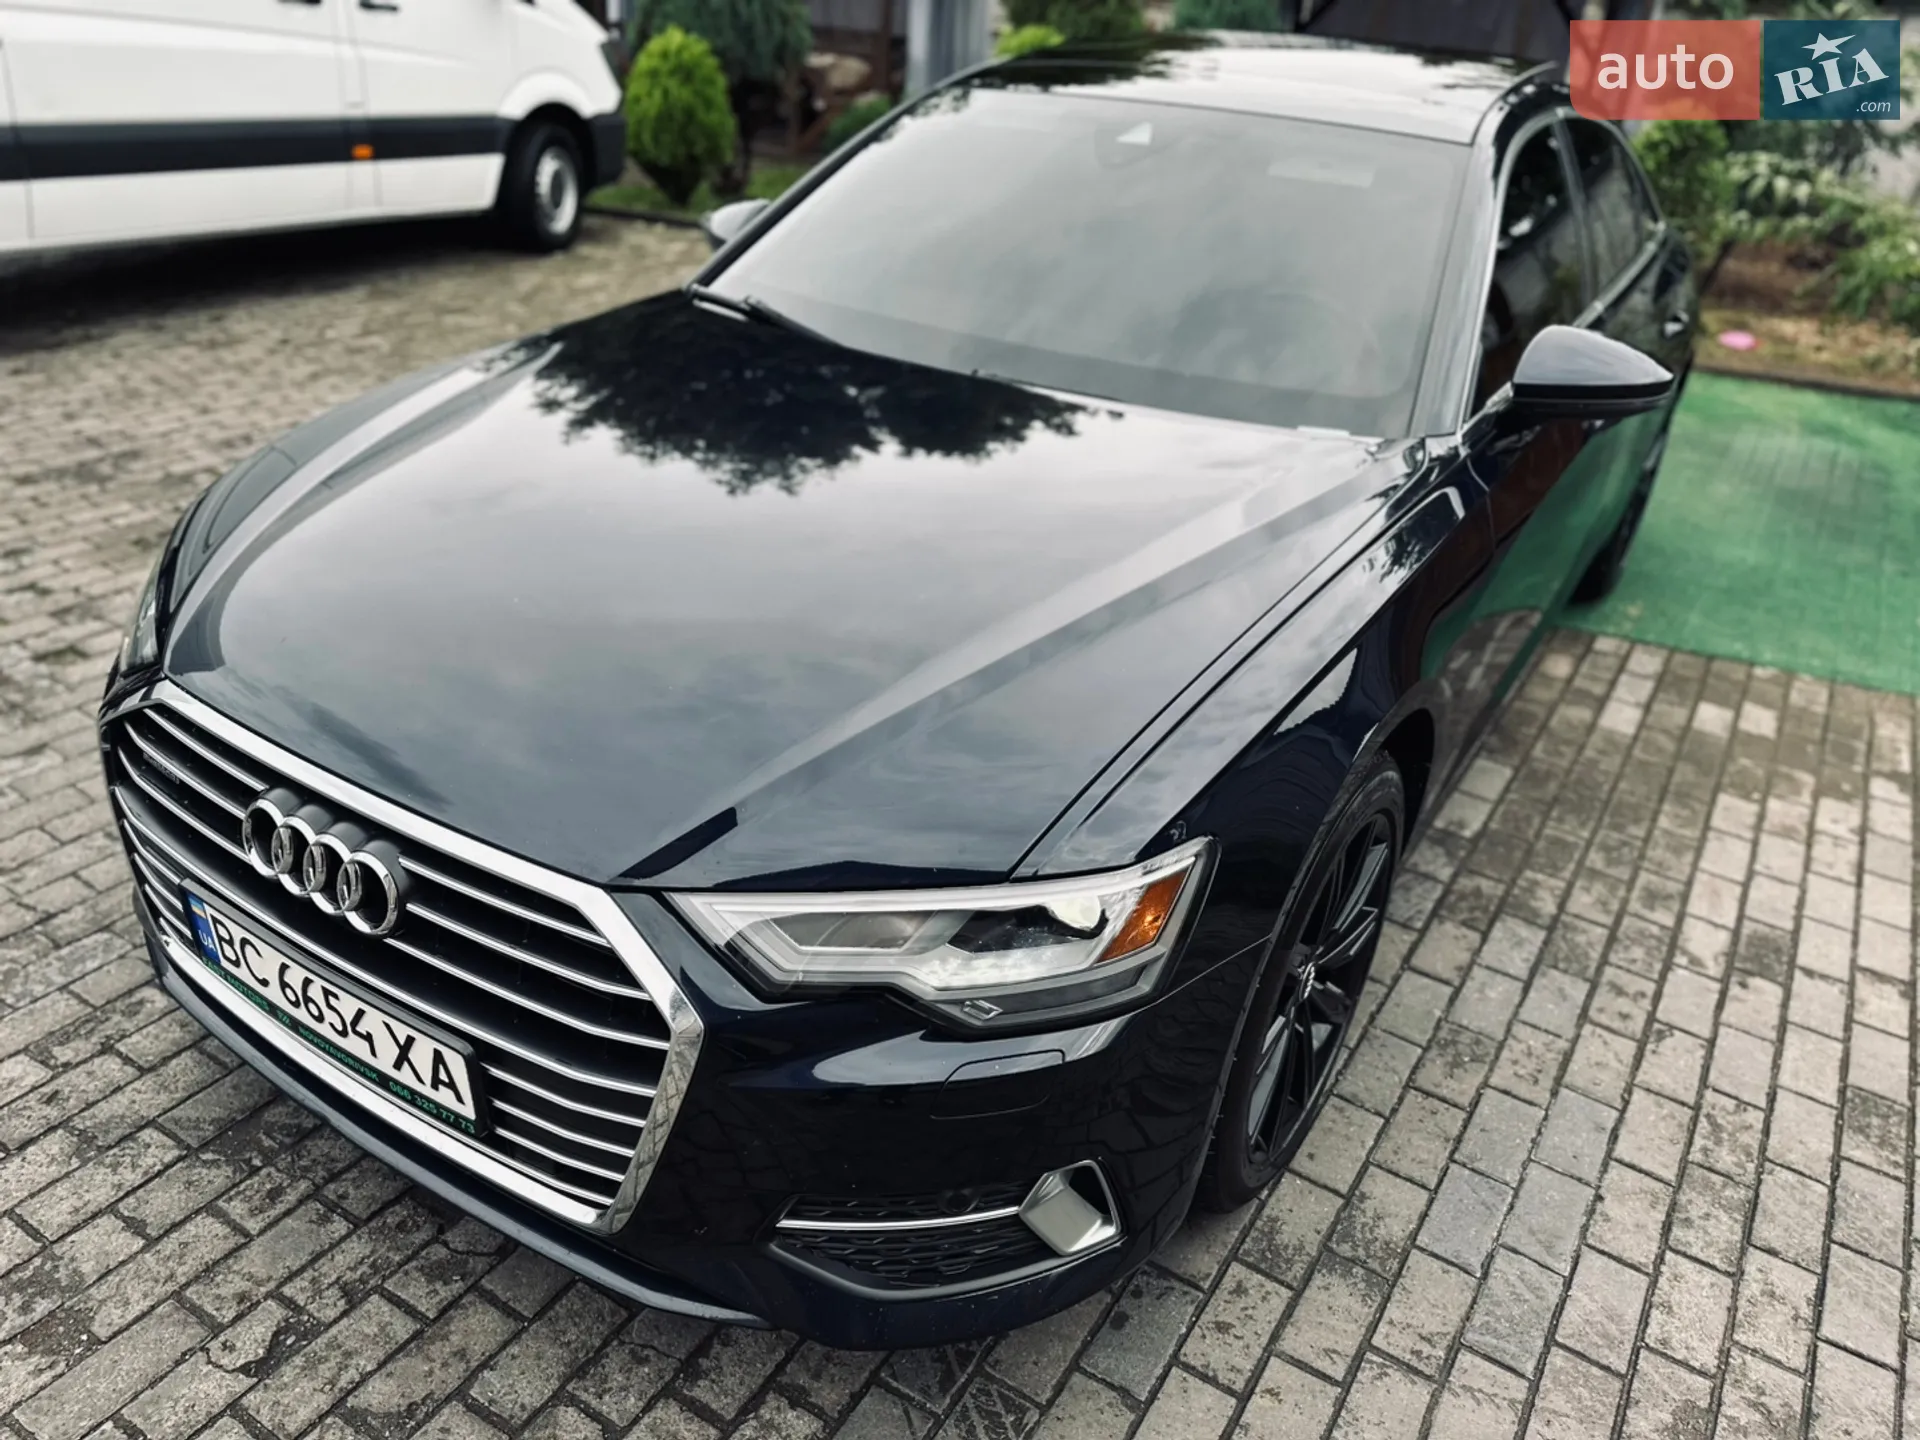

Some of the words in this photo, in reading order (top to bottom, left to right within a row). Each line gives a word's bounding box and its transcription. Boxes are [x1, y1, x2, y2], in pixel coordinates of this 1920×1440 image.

[198, 929, 217, 952] UA
[209, 913, 270, 988] BC
[278, 962, 378, 1059] 6654
[382, 1019, 466, 1106] XA
[440, 1108, 455, 1123] 77
[460, 1119, 475, 1134] 73
